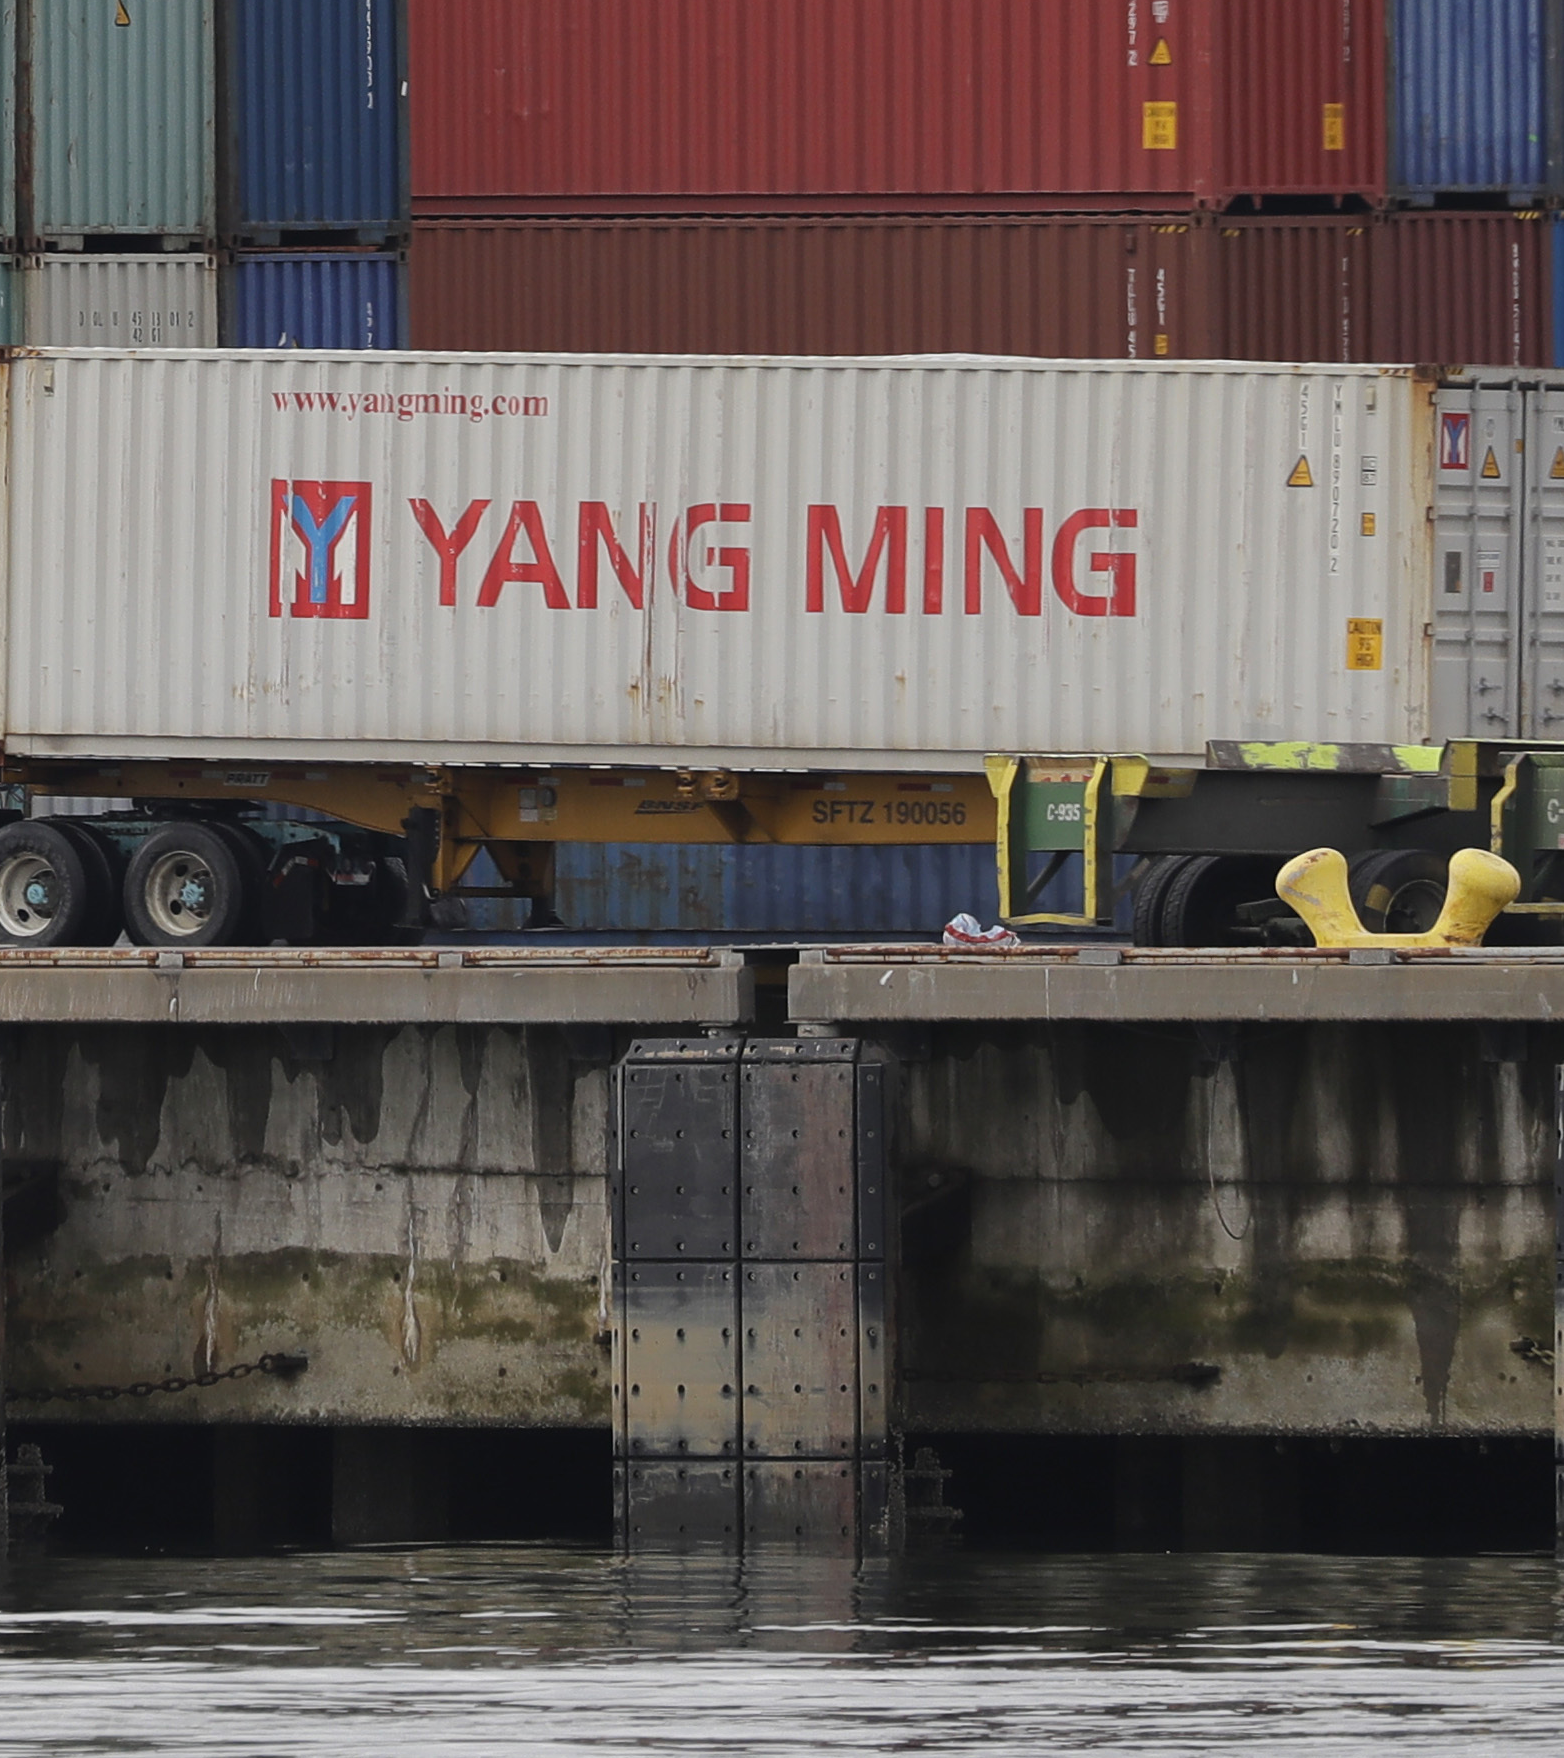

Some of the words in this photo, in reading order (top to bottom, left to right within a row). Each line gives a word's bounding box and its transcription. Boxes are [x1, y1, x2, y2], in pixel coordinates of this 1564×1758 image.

[271, 386, 549, 423] www.yangming.com
[408, 498, 752, 612] YANG
[806, 503, 1138, 617] MING
[812, 799, 876, 825] SFTZ
[883, 801, 967, 826] 190056
[1047, 803, 1081, 822] C-935
